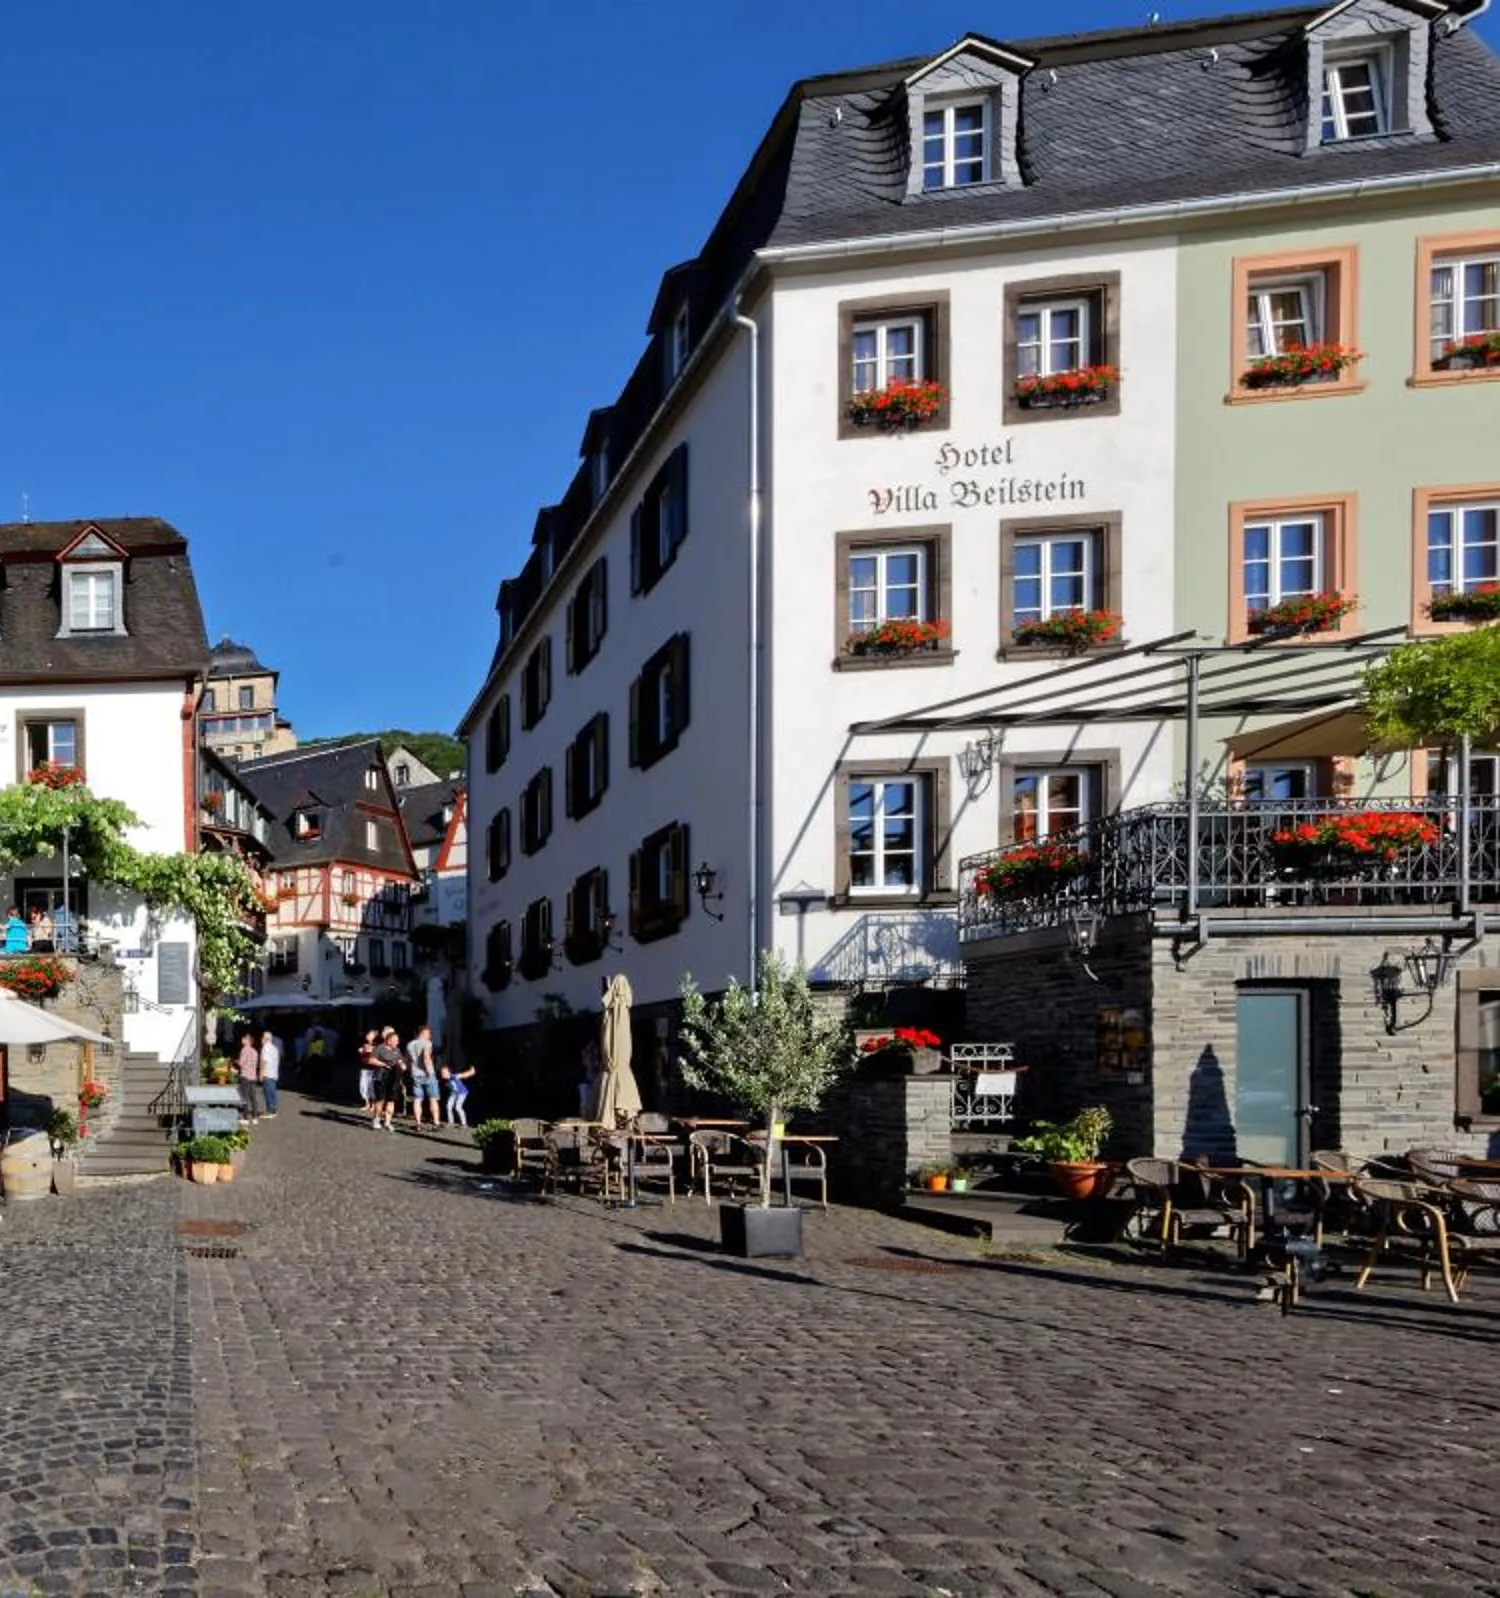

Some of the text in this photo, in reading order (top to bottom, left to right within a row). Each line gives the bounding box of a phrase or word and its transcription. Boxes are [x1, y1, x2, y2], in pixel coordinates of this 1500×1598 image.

[935, 438, 1014, 475] Hotel
[868, 473, 1086, 514] Villa Beilstein
